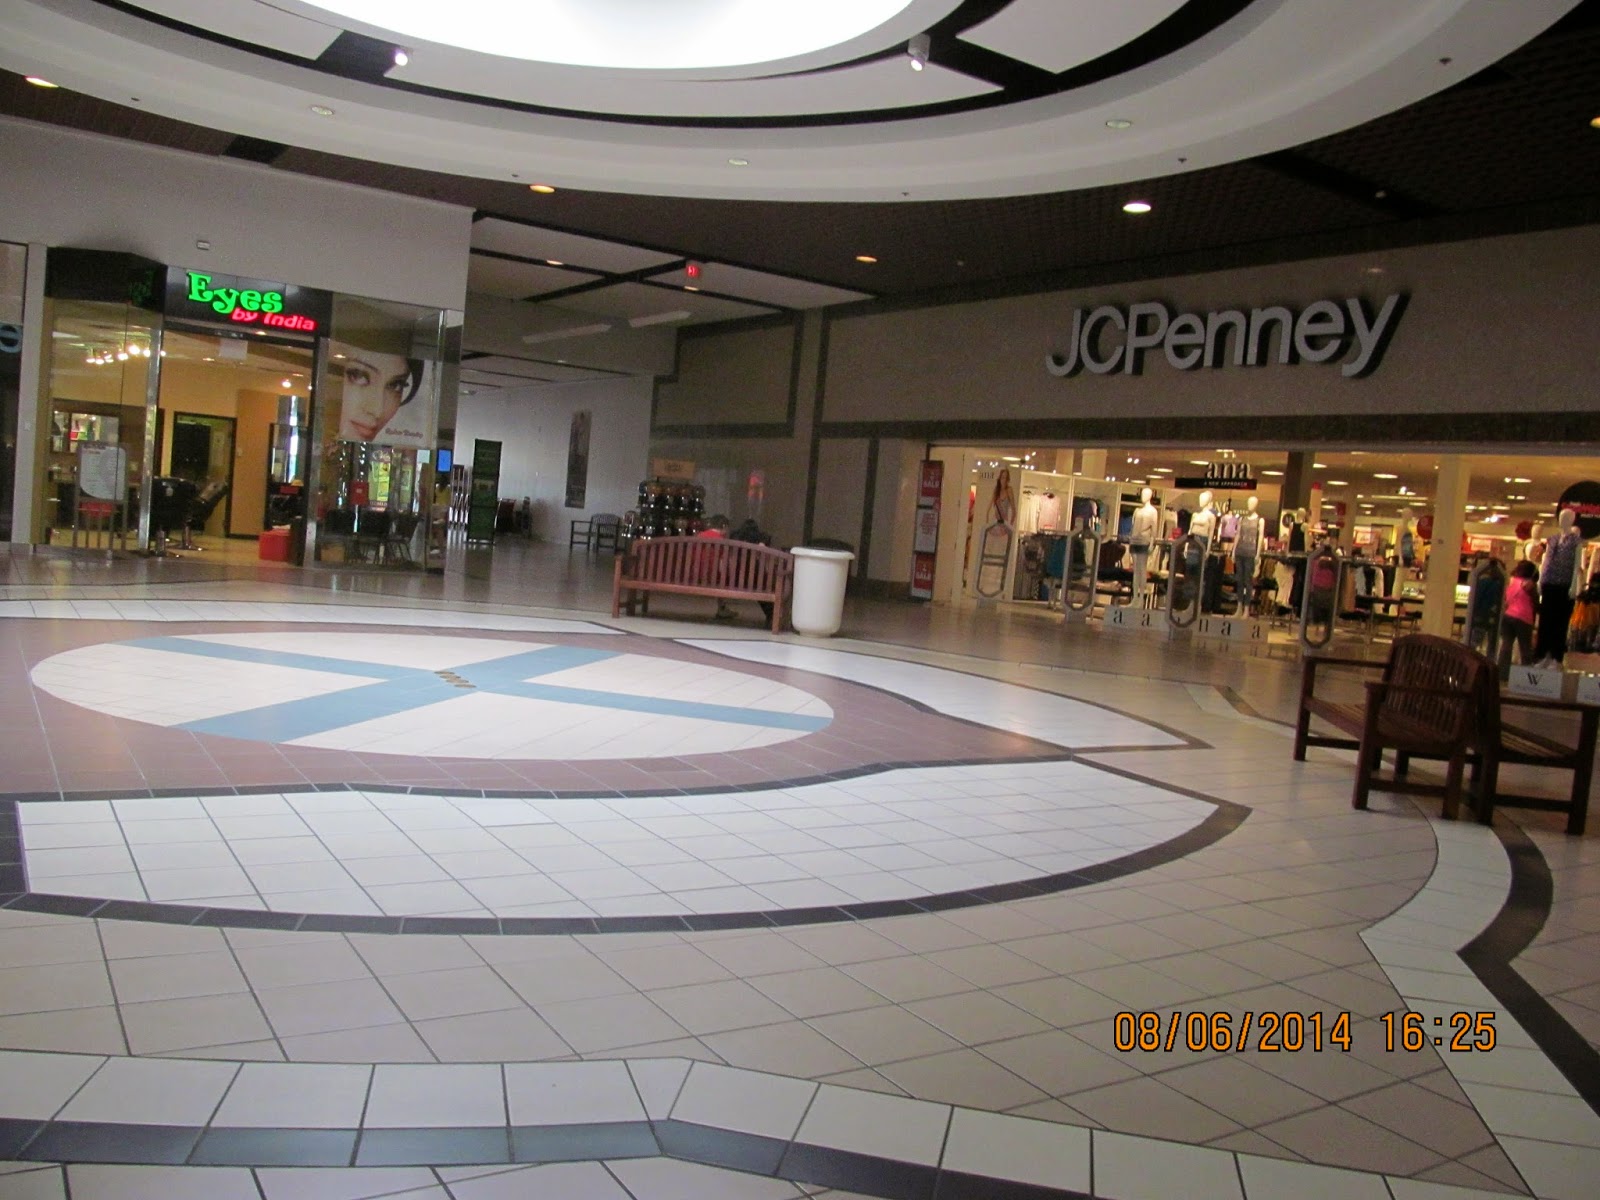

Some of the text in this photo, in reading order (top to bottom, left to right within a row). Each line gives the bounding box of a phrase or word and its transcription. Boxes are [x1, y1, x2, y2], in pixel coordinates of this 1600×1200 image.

[186, 271, 284, 314] Eyes
[231, 307, 317, 331] by India
[1045, 294, 1402, 378] JCPenney
